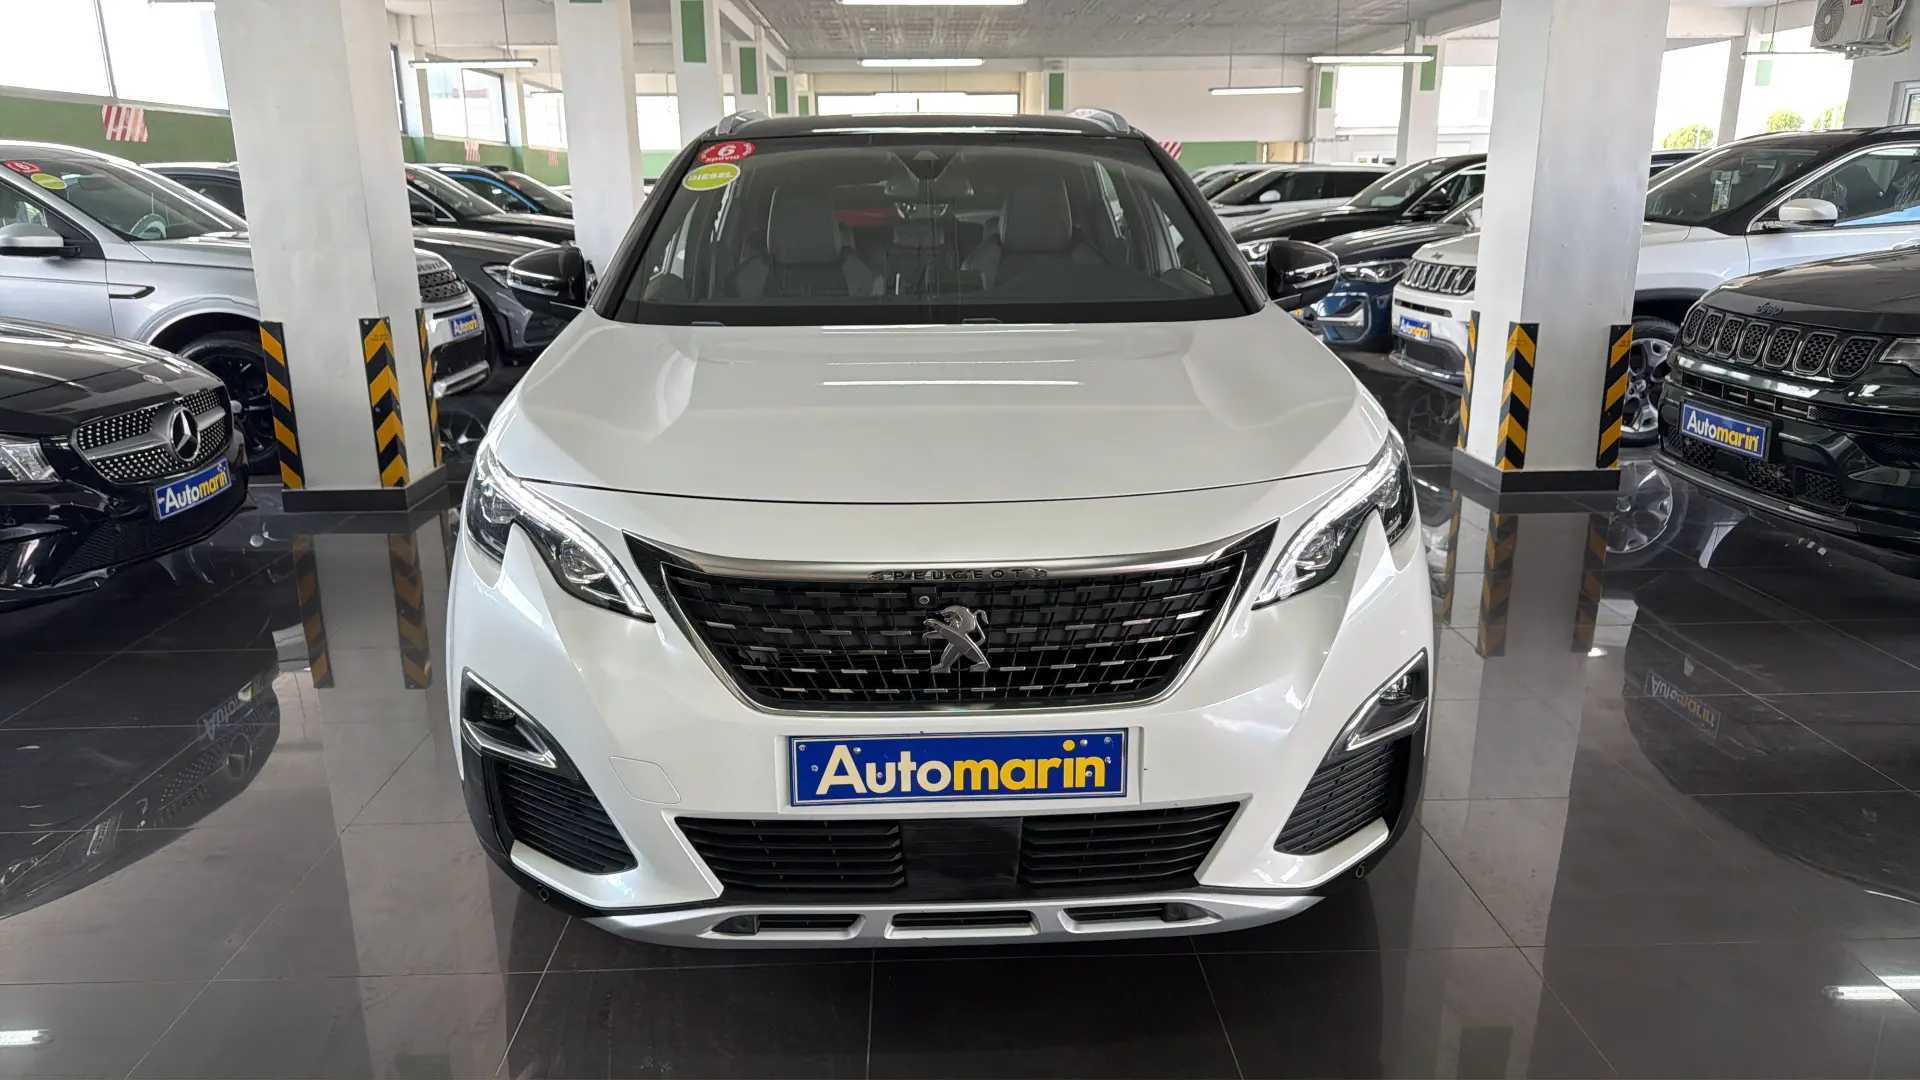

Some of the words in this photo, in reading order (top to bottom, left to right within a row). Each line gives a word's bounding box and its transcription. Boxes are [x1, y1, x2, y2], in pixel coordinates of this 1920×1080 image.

[718, 144, 737, 157] 6
[687, 171, 733, 182] DIESEL
[1756, 302, 1784, 317] Jeep
[1686, 409, 1760, 452] Automarin
[165, 464, 229, 514] Automarin
[894, 568, 1023, 580] PEUGEOT
[815, 739, 1106, 795] Automarin
